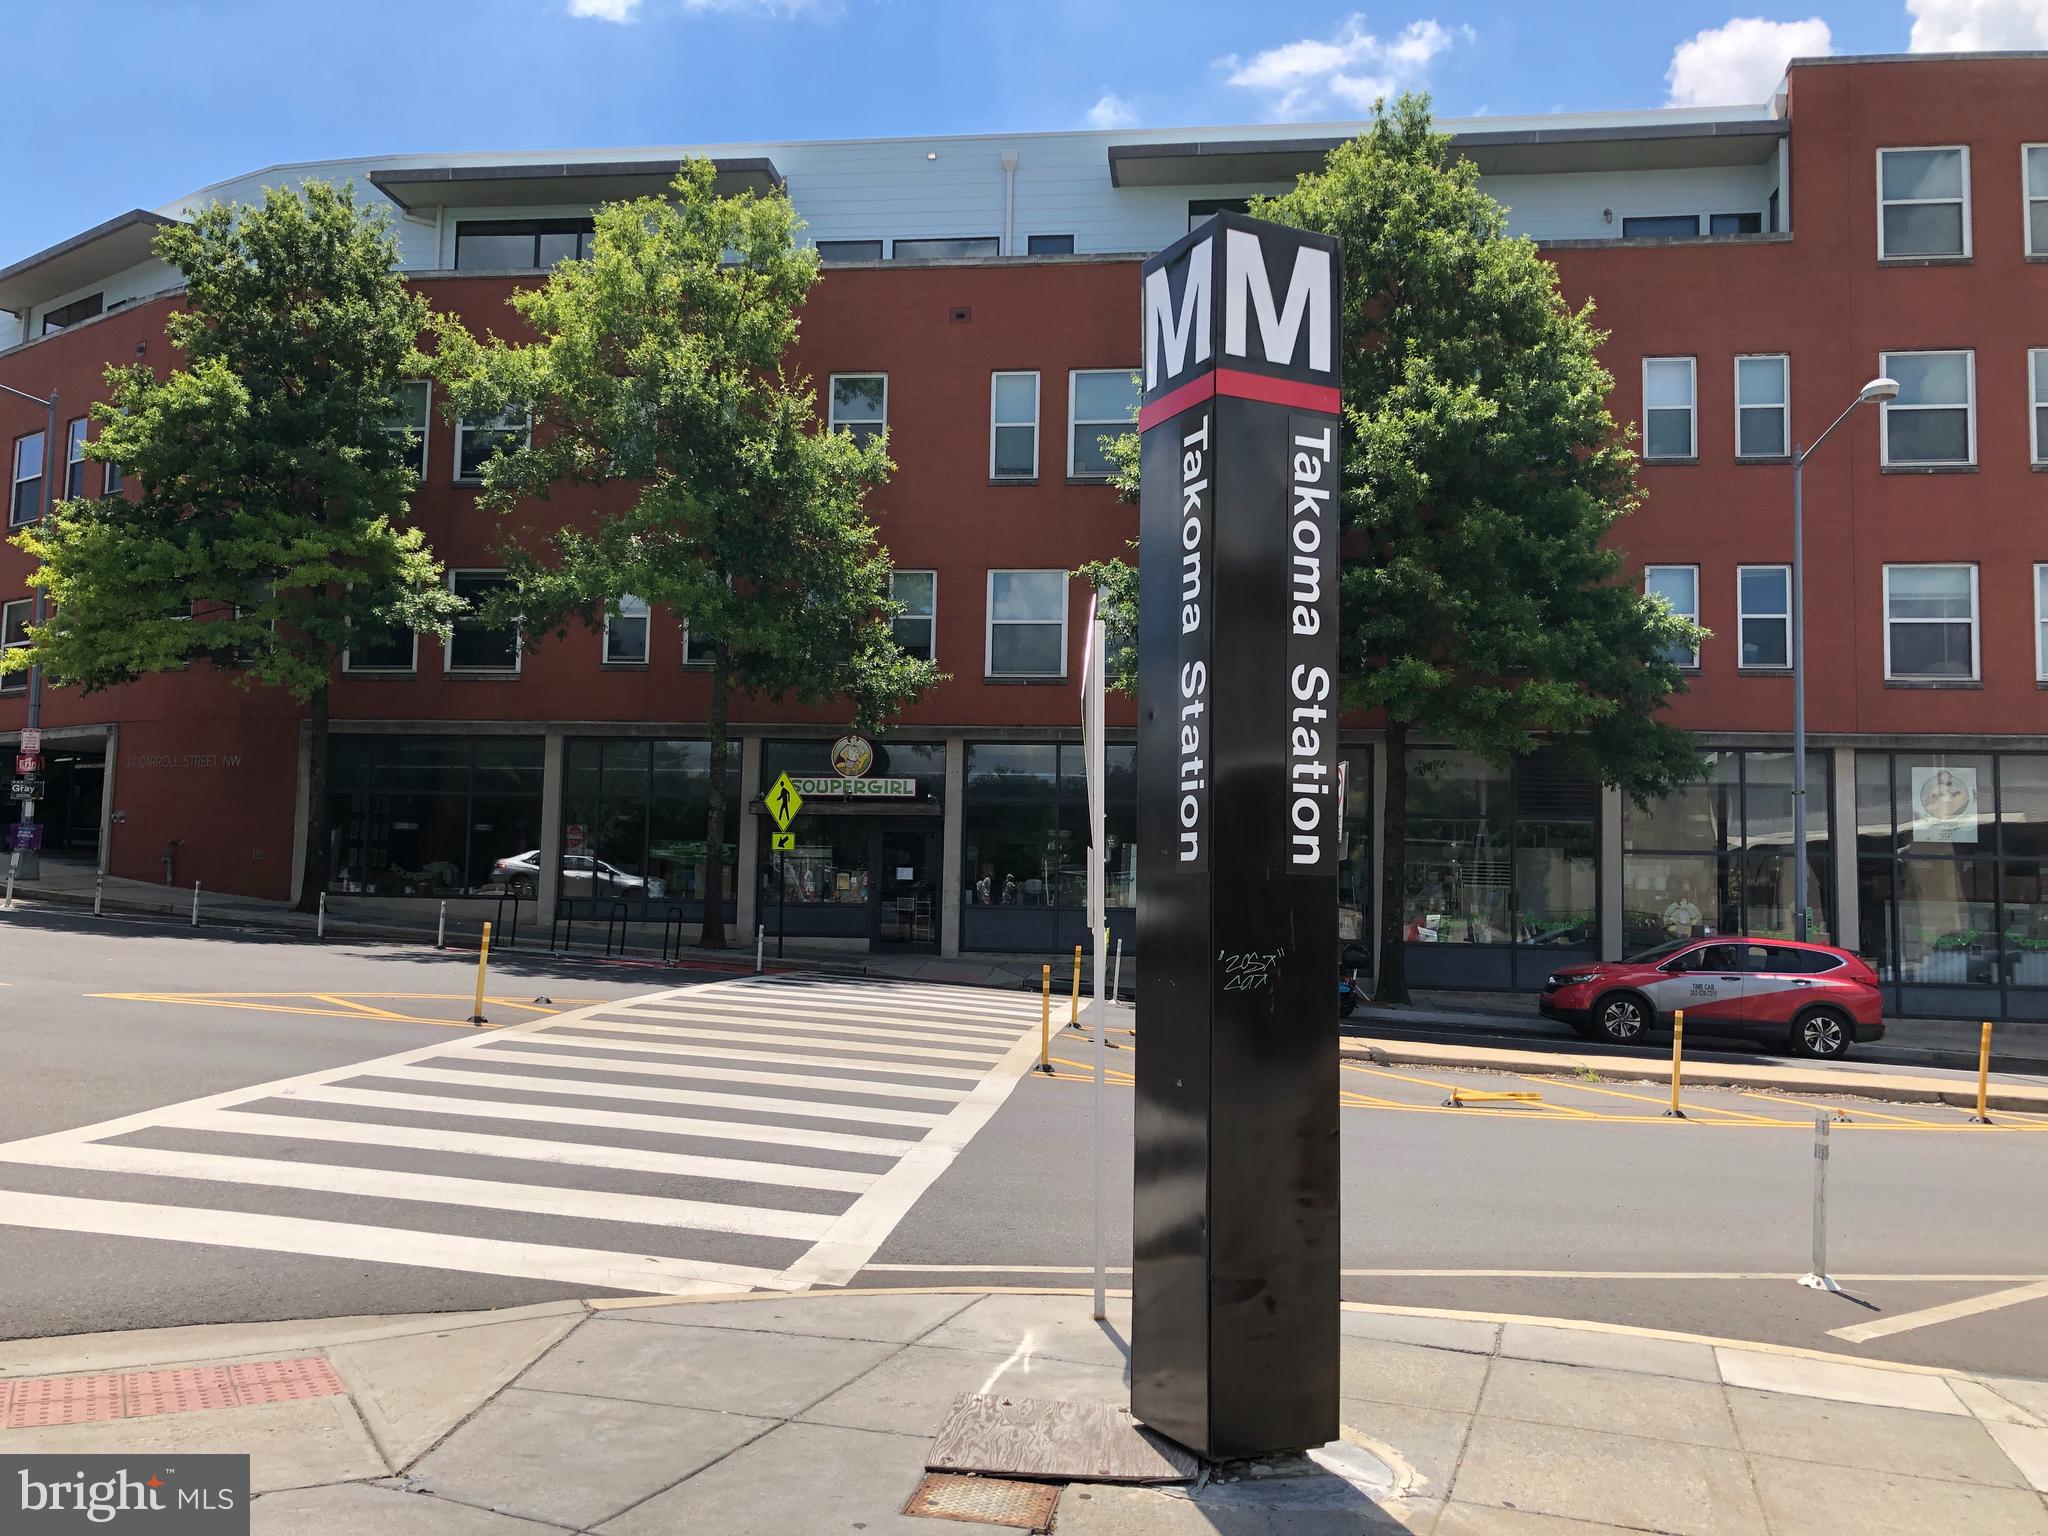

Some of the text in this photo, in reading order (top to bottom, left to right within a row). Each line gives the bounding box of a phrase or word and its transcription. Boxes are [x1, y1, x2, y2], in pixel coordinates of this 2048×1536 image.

[1146, 236, 1213, 392] M
[1225, 228, 1331, 373] M
[1180, 414, 1209, 862] Takoma Station
[1291, 428, 1331, 865] Takoma Station
[12, 784, 35, 794] Gray
[184, 754, 218, 768] STREET
[222, 754, 242, 768] NW
[793, 779, 914, 795] SOUPERGIRL
